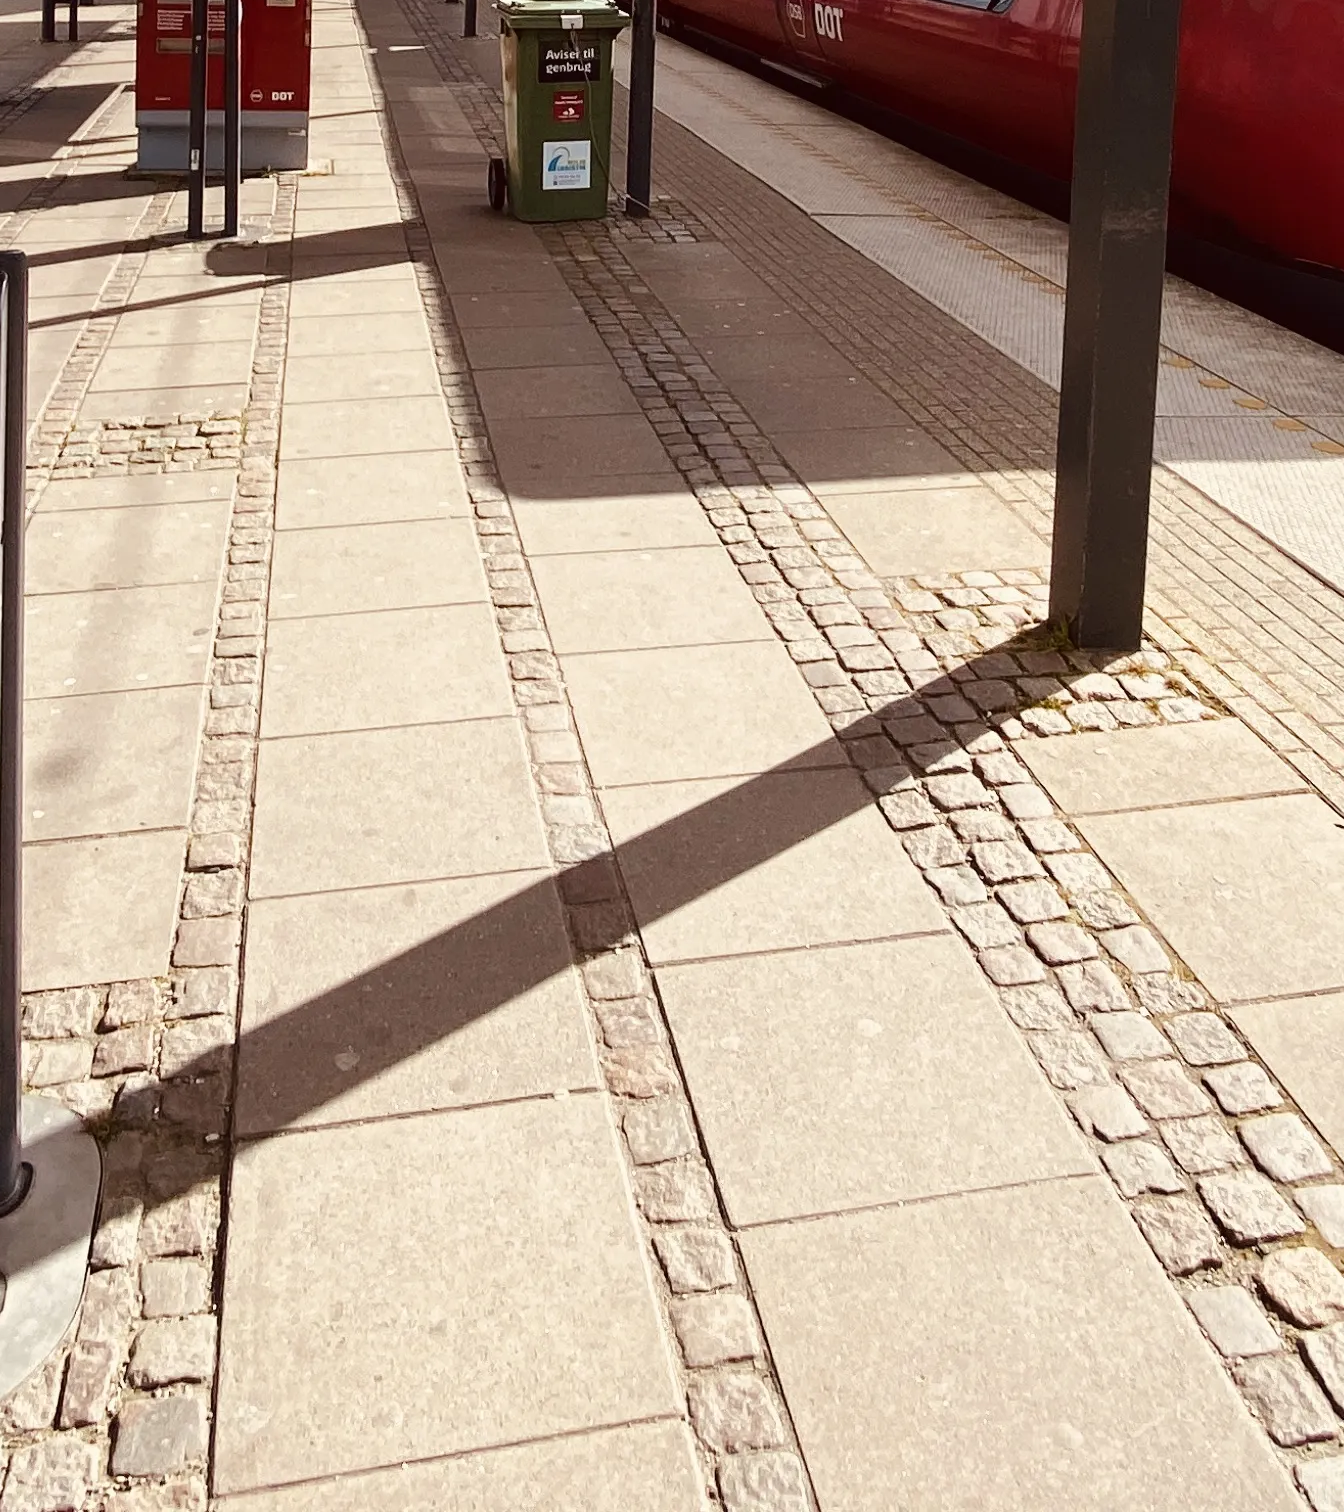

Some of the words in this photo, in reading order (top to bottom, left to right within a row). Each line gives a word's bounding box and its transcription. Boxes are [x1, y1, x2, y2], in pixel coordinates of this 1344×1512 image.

[815, 2, 844, 42] DOT
[545, 49, 580, 60] Aviser
[583, 48, 595, 59] til
[546, 62, 591, 74] genbrug
[271, 91, 295, 101] DOT
